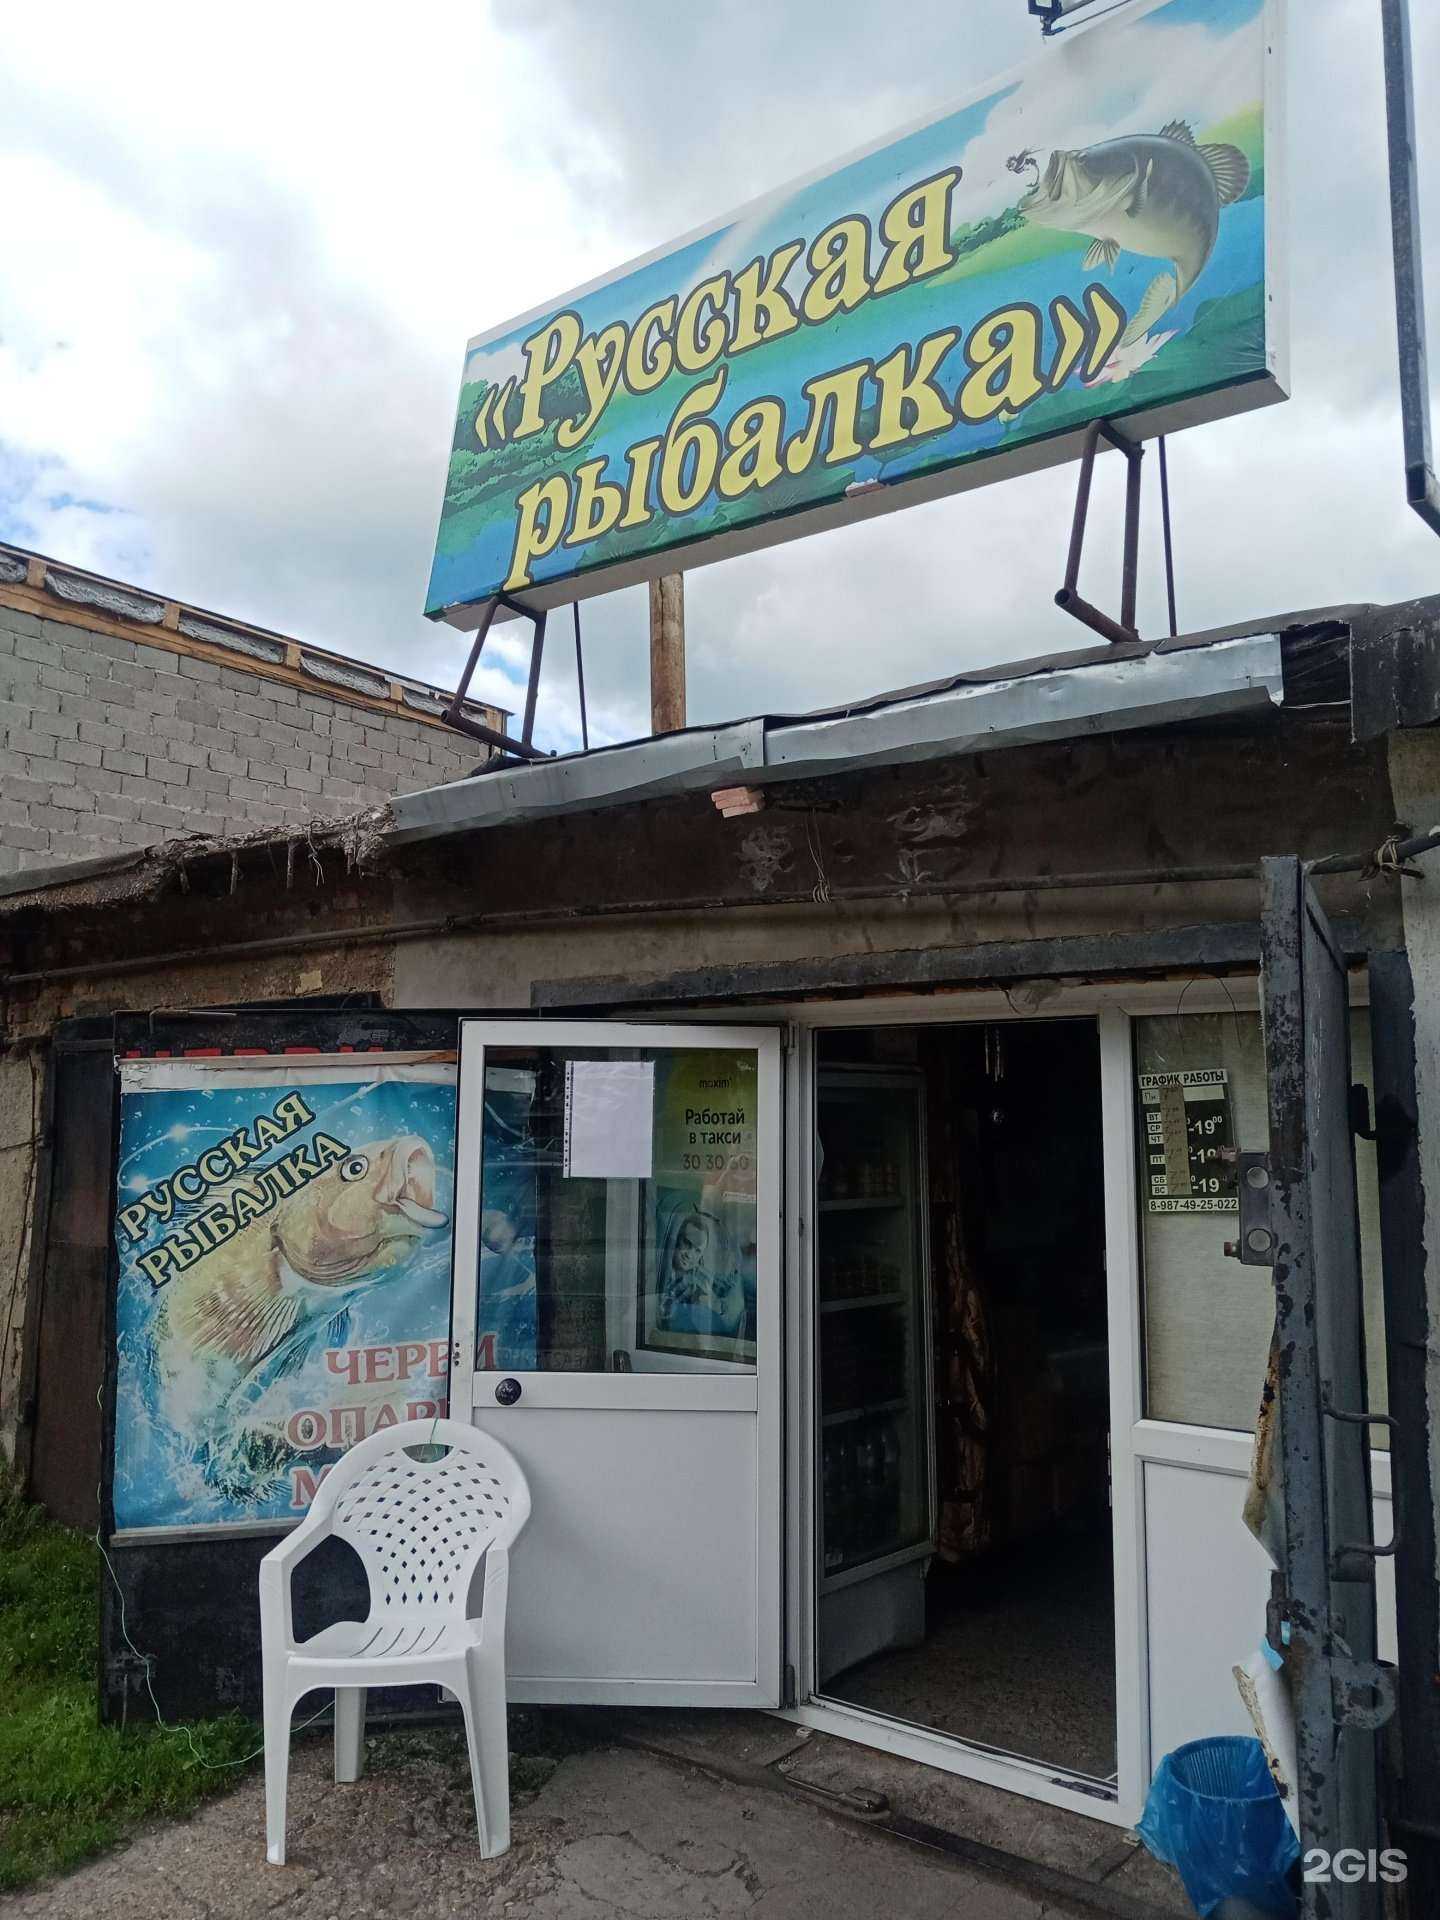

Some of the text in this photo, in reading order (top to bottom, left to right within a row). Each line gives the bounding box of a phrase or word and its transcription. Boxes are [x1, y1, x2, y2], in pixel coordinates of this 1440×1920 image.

[472, 167, 963, 449] «Русская
[504, 282, 1128, 591] рыбалка»
[685, 1108, 745, 1125] Работай
[1141, 1071, 1225, 1086] ГРАФИК РАБОТЫ
[117, 1090, 316, 1243] РУССКАЯ
[689, 1132, 742, 1145] в такси
[137, 1132, 351, 1289] РЫБАЛКА
[1150, 1199, 1237, 1210] 8-987-49-25-022
